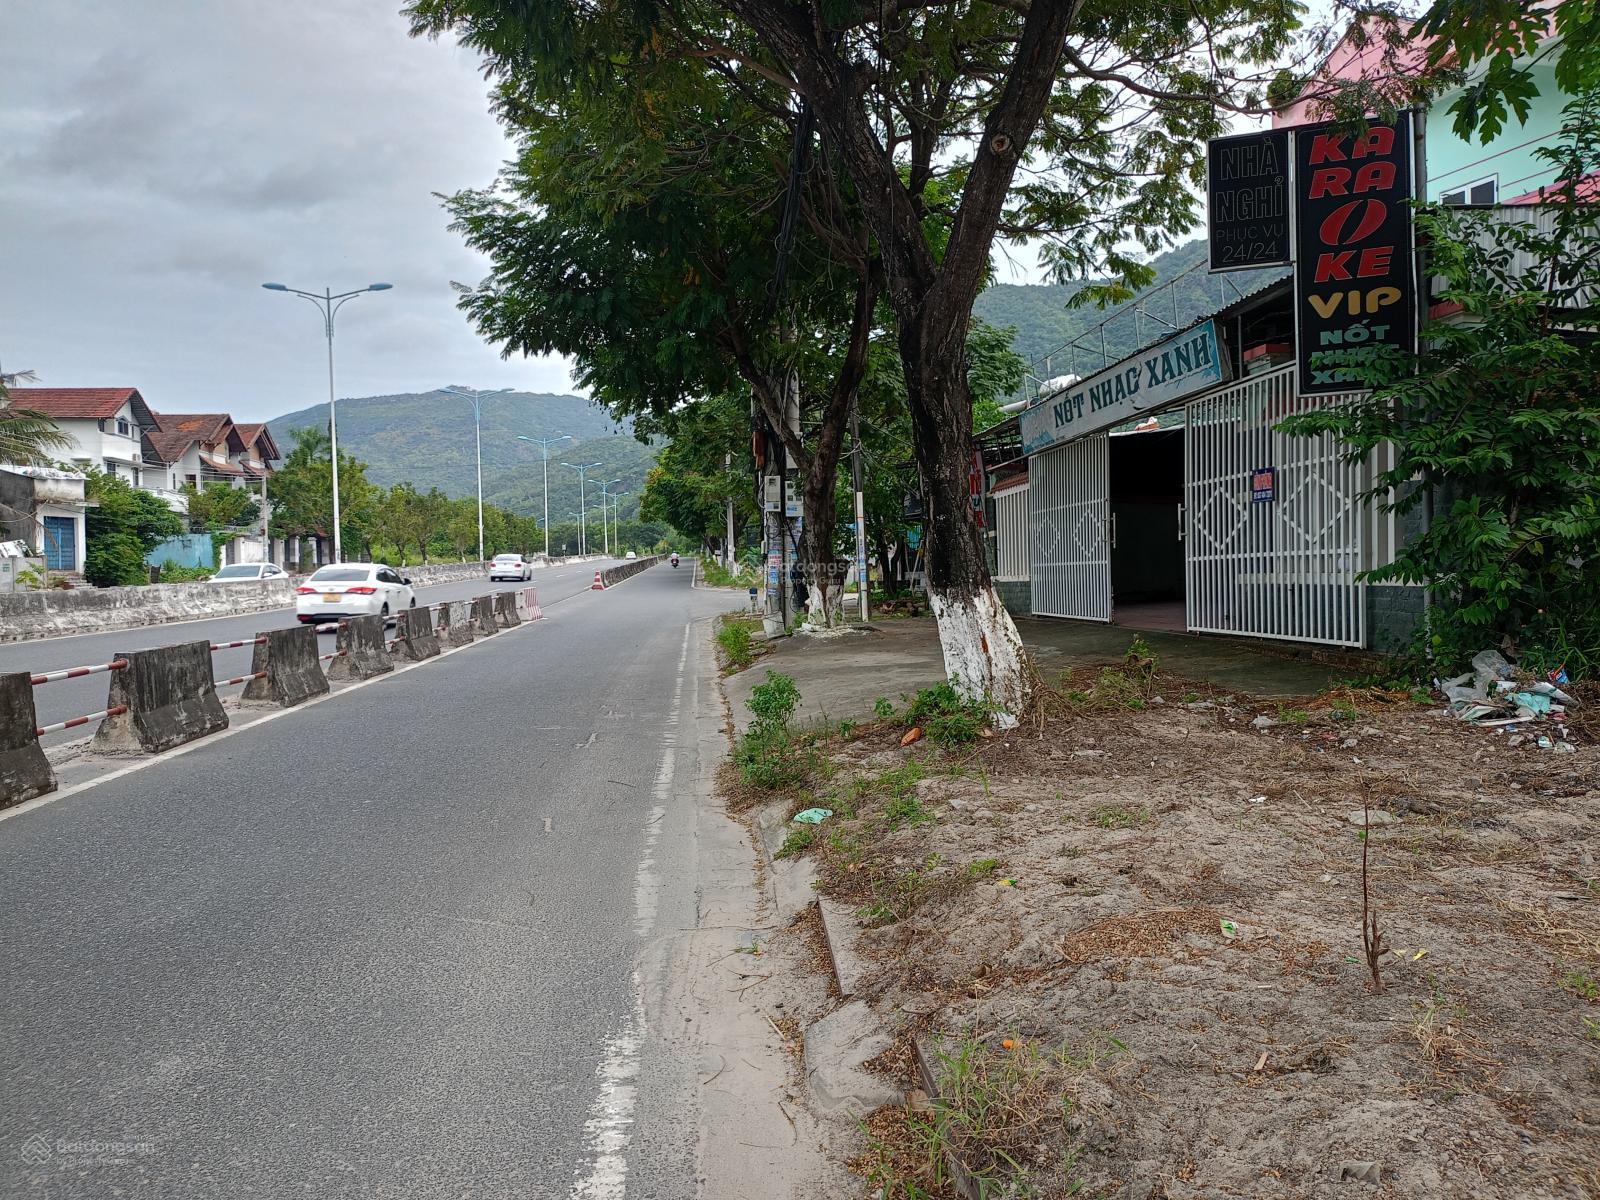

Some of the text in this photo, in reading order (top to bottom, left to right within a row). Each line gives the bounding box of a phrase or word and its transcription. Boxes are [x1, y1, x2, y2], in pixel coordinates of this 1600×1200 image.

[1220, 136, 1279, 180] NHÀ
[1309, 126, 1396, 165] KA
[1215, 176, 1284, 222] NGHỈ
[1309, 161, 1396, 199] RA
[1319, 198, 1387, 245] O
[1221, 241, 1279, 263] 24/24
[1314, 246, 1394, 283] KE
[1308, 287, 1402, 319] VIP
[1319, 319, 1391, 345] NỐT
[1053, 333, 1212, 428] NỐT NHẠC XANH
